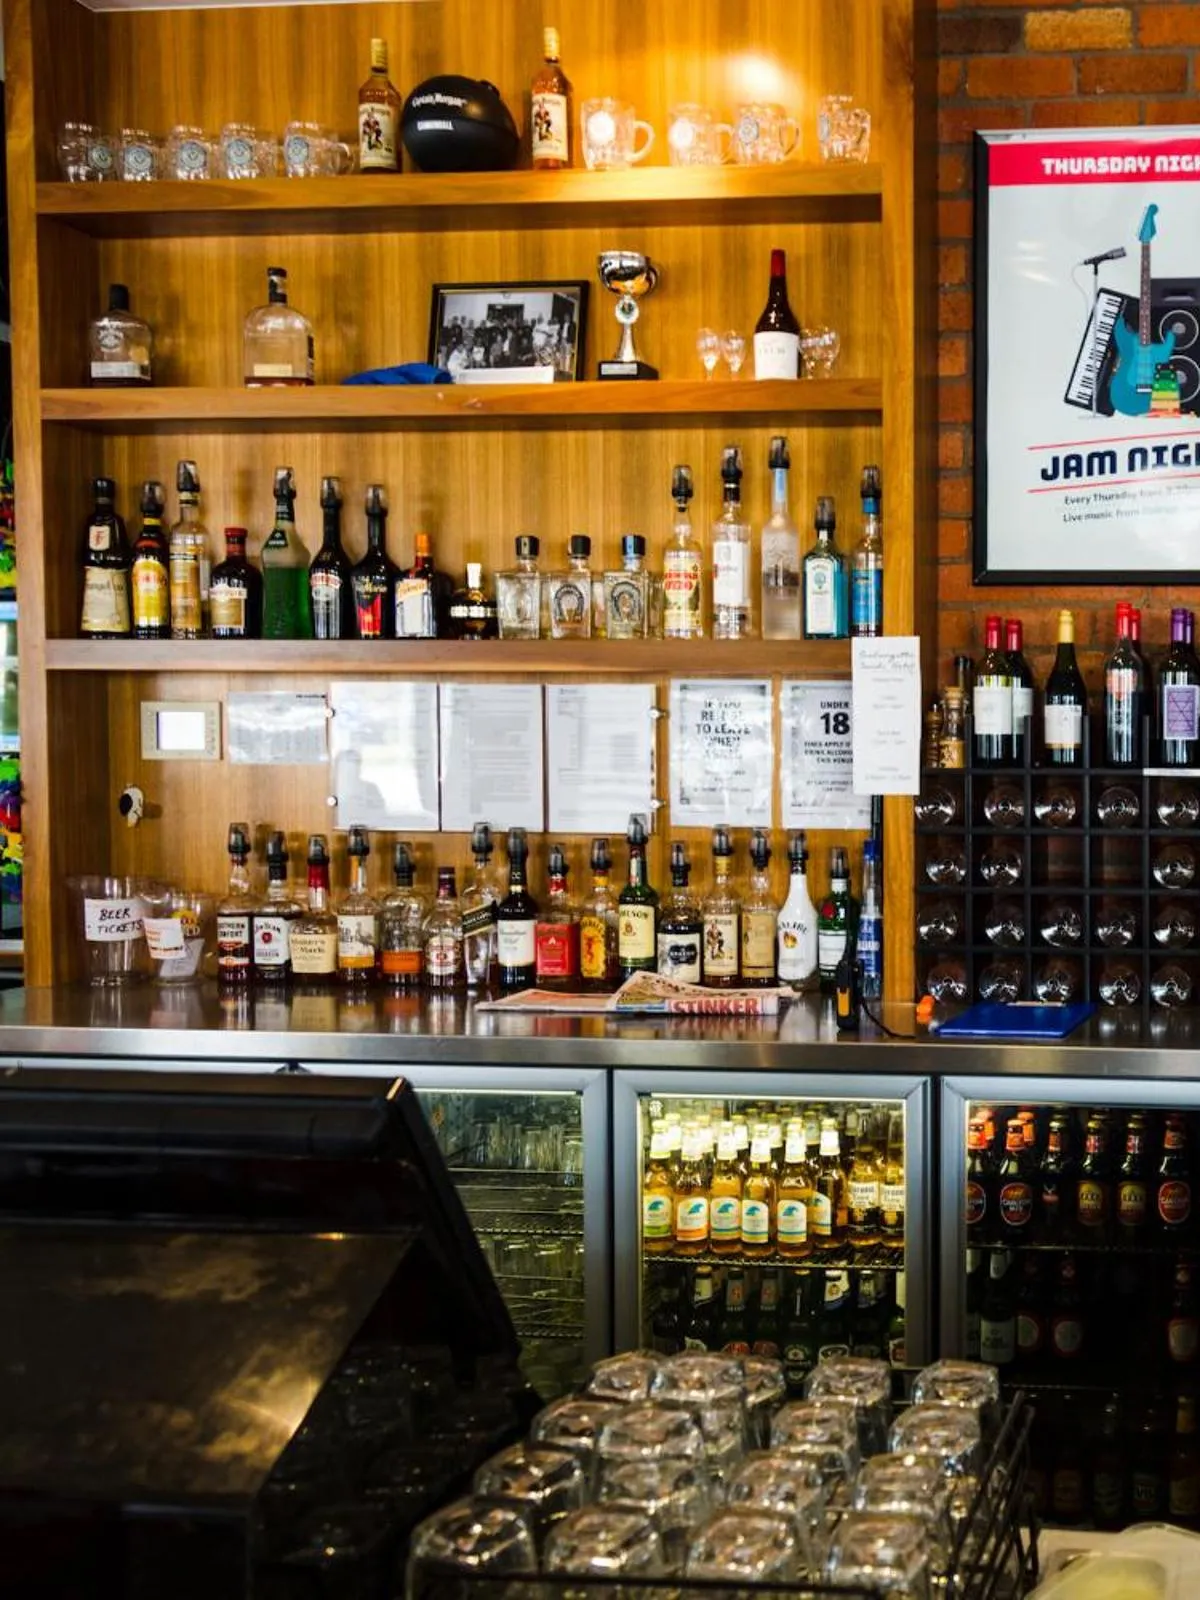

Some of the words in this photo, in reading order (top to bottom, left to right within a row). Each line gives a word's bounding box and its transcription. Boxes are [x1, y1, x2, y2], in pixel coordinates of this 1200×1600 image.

[1041, 155, 1151, 175] THURSDAY
[1040, 450, 1118, 481] JAM
[1064, 494, 1091, 506] Every
[1063, 512, 1083, 523] Live
[1083, 510, 1114, 521] music
[820, 701, 850, 710] UNDER
[696, 724, 712, 735] TO
[820, 712, 850, 735] 18
[824, 741, 844, 749] APPLY
[99, 907, 131, 921] BEER
[97, 918, 143, 935] TICKETS
[671, 998, 761, 1014] STINKER
